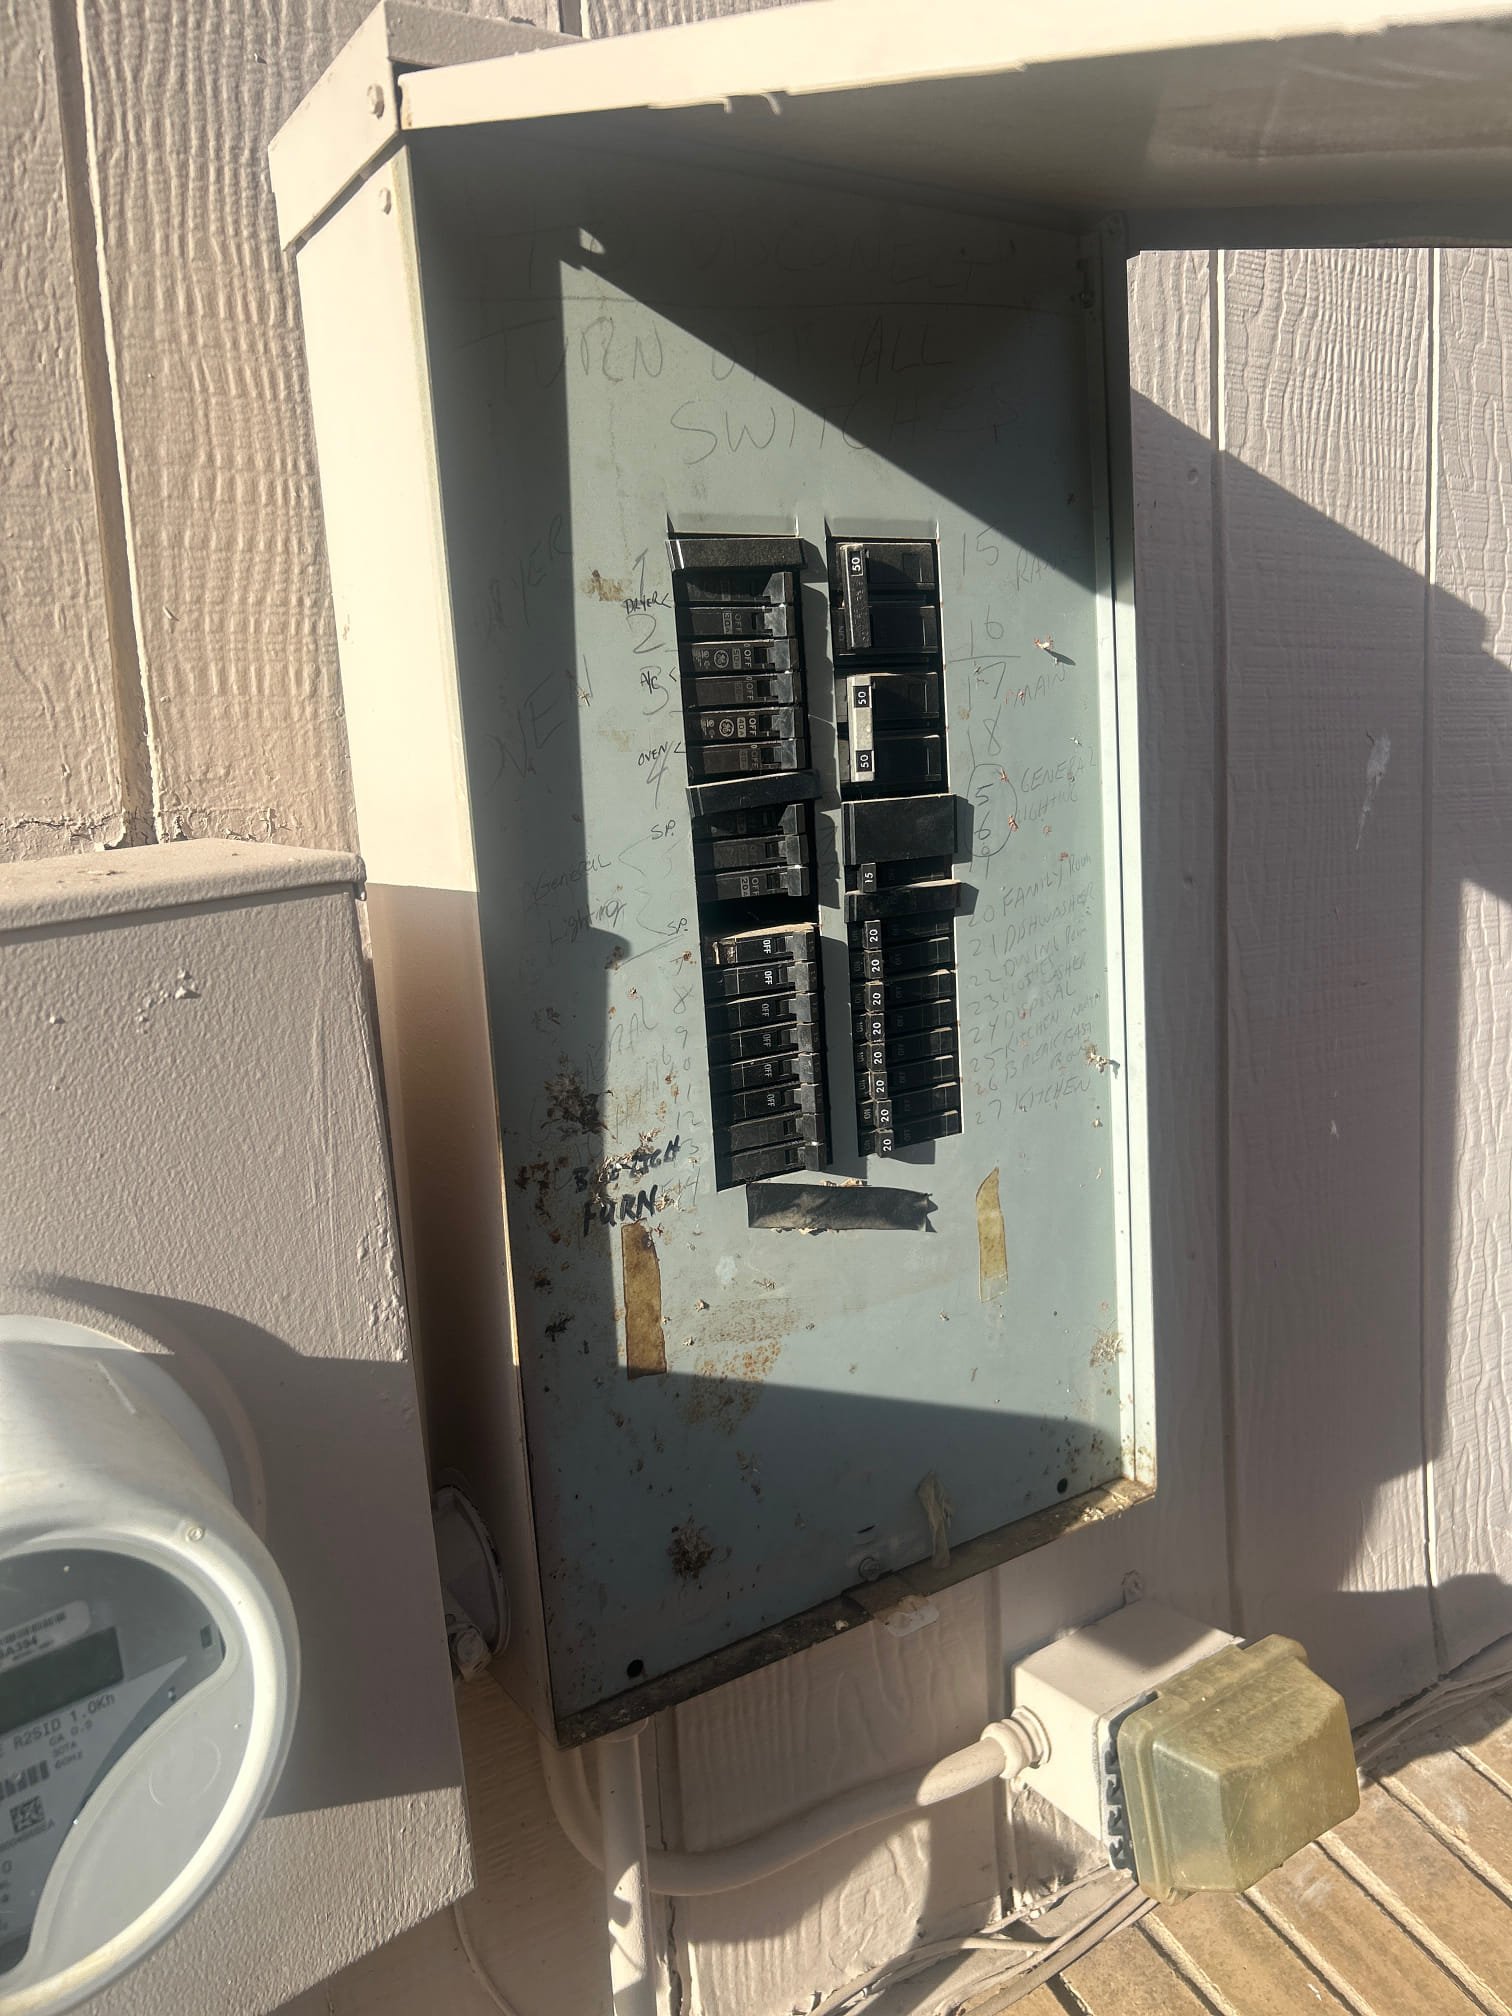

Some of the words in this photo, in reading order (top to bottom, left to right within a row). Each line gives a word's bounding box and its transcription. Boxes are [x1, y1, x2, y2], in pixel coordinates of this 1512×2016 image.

[855, 316, 952, 386] ALL
[961, 520, 1000, 577] 15
[851, 556, 861, 572] 50
[625, 613, 666, 654] 2
[970, 604, 1004, 657] 16
[744, 649, 752, 668] OFF
[857, 691, 867, 706] 50
[748, 717, 757, 737] OFF
[638, 740, 668, 766] OVEN
[859, 754, 869, 769] 50
[645, 740, 671, 811] 4
[864, 871, 874, 884] 15
[870, 929, 878, 942] 20
[763, 940, 772, 954] OFF
[872, 959, 880, 973] 20
[764, 970, 773, 984] OFF
[872, 992, 882, 1006] 20
[761, 1003, 770, 1017] OFF
[873, 1021, 882, 1036] 20
[968, 1014, 1001, 1046] 24
[674, 1025, 689, 1050] 9
[762, 1033, 772, 1047] OFF
[874, 1051, 882, 1065] 20
[764, 1063, 773, 1078] OFF
[876, 1080, 885, 1094] 20
[766, 1094, 776, 1108] OFF
[880, 1109, 890, 1123] 20
[883, 1138, 892, 1152] 20
